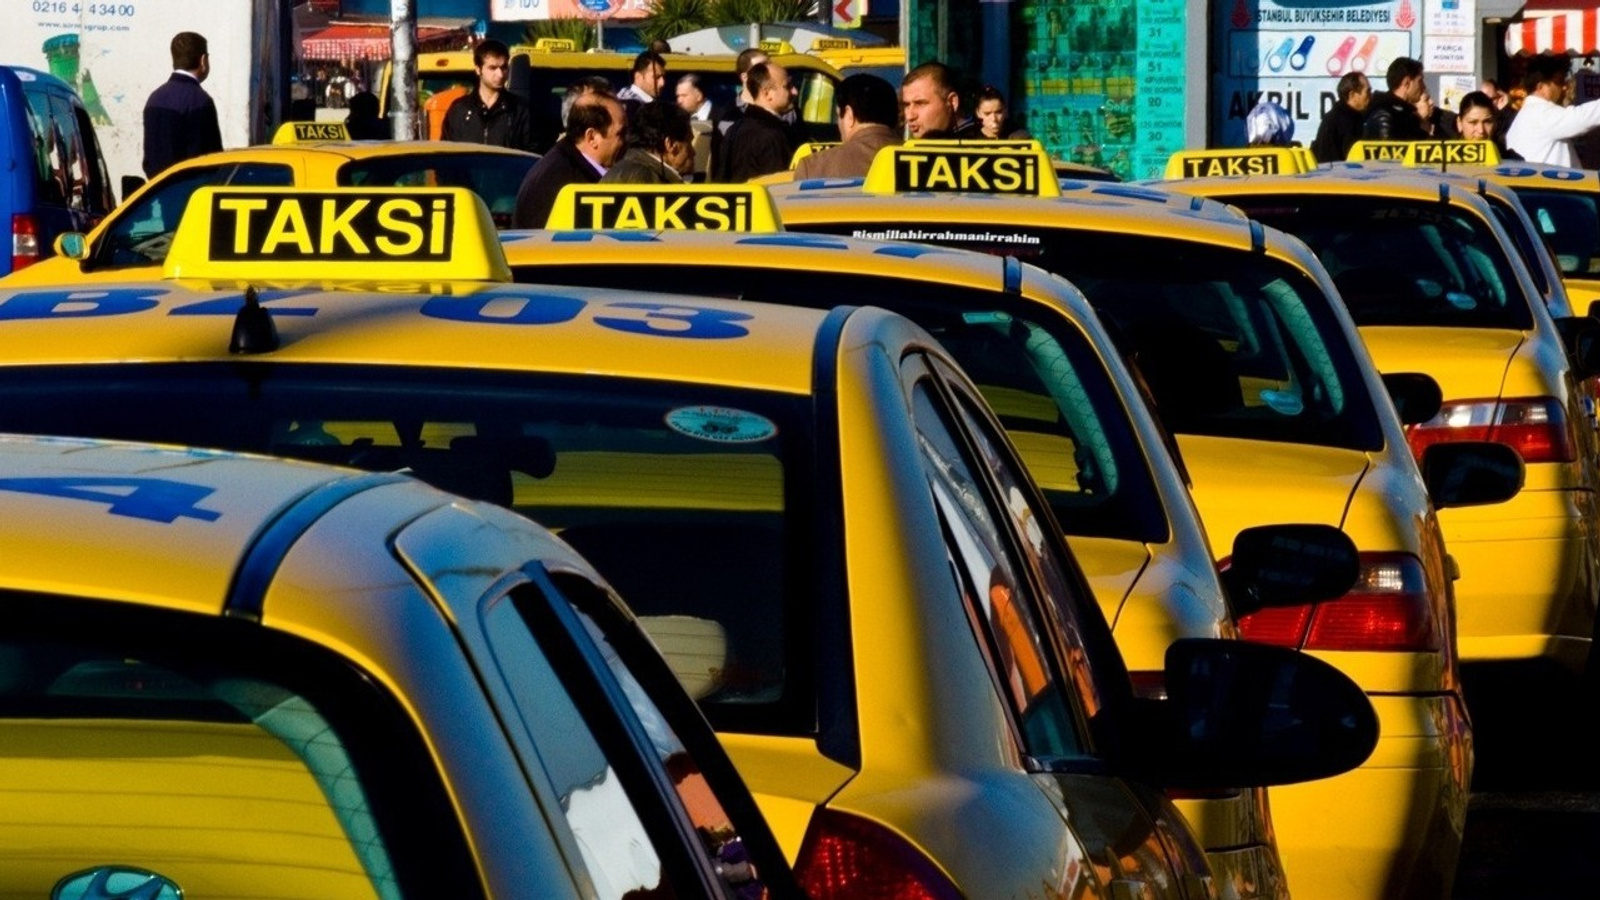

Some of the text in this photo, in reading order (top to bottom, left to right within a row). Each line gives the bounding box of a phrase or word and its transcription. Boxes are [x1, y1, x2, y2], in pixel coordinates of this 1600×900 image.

[32, 1, 67, 13] 0216
[1148, 27, 1162, 38] 31
[1147, 61, 1162, 73] 51
